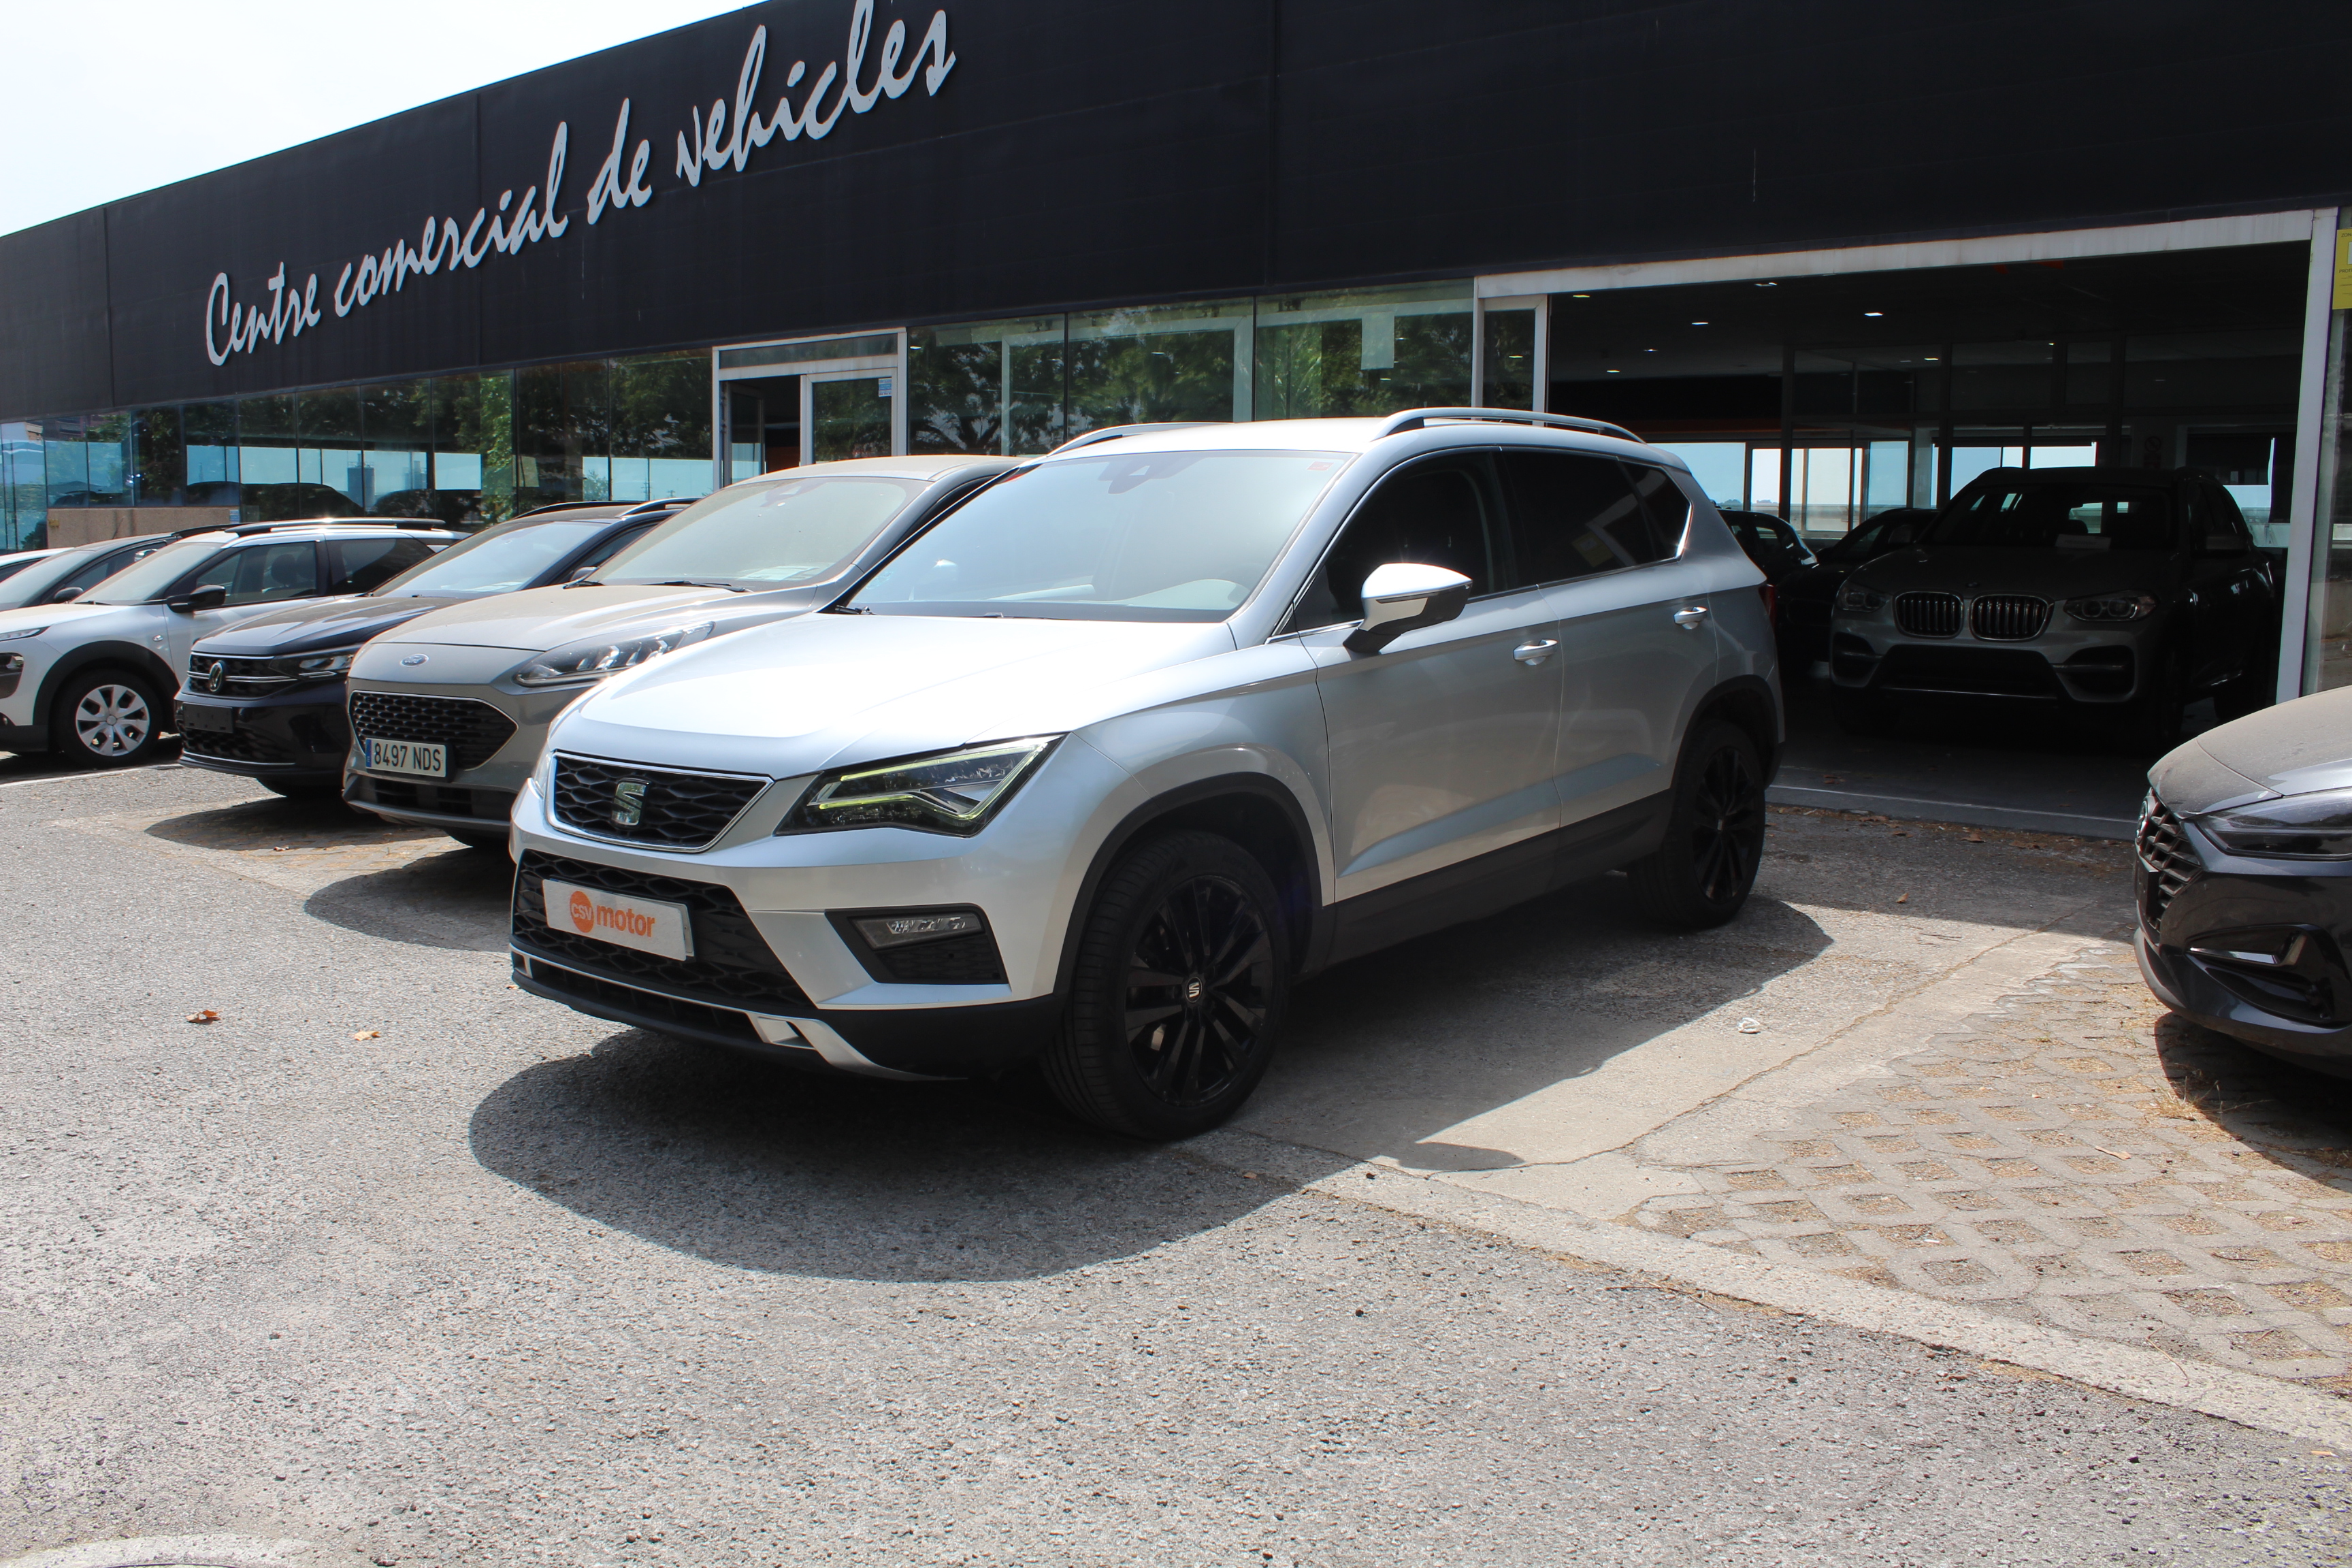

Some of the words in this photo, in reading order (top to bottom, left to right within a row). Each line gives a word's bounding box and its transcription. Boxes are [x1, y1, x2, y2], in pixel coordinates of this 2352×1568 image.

[206, 261, 321, 365] Centre
[334, 121, 568, 317] comercial
[587, 97, 652, 225] de
[676, 0, 956, 186] vehicles
[374, 742, 408, 768] 8497
[412, 747, 441, 772] NDS
[596, 904, 655, 938] motor
